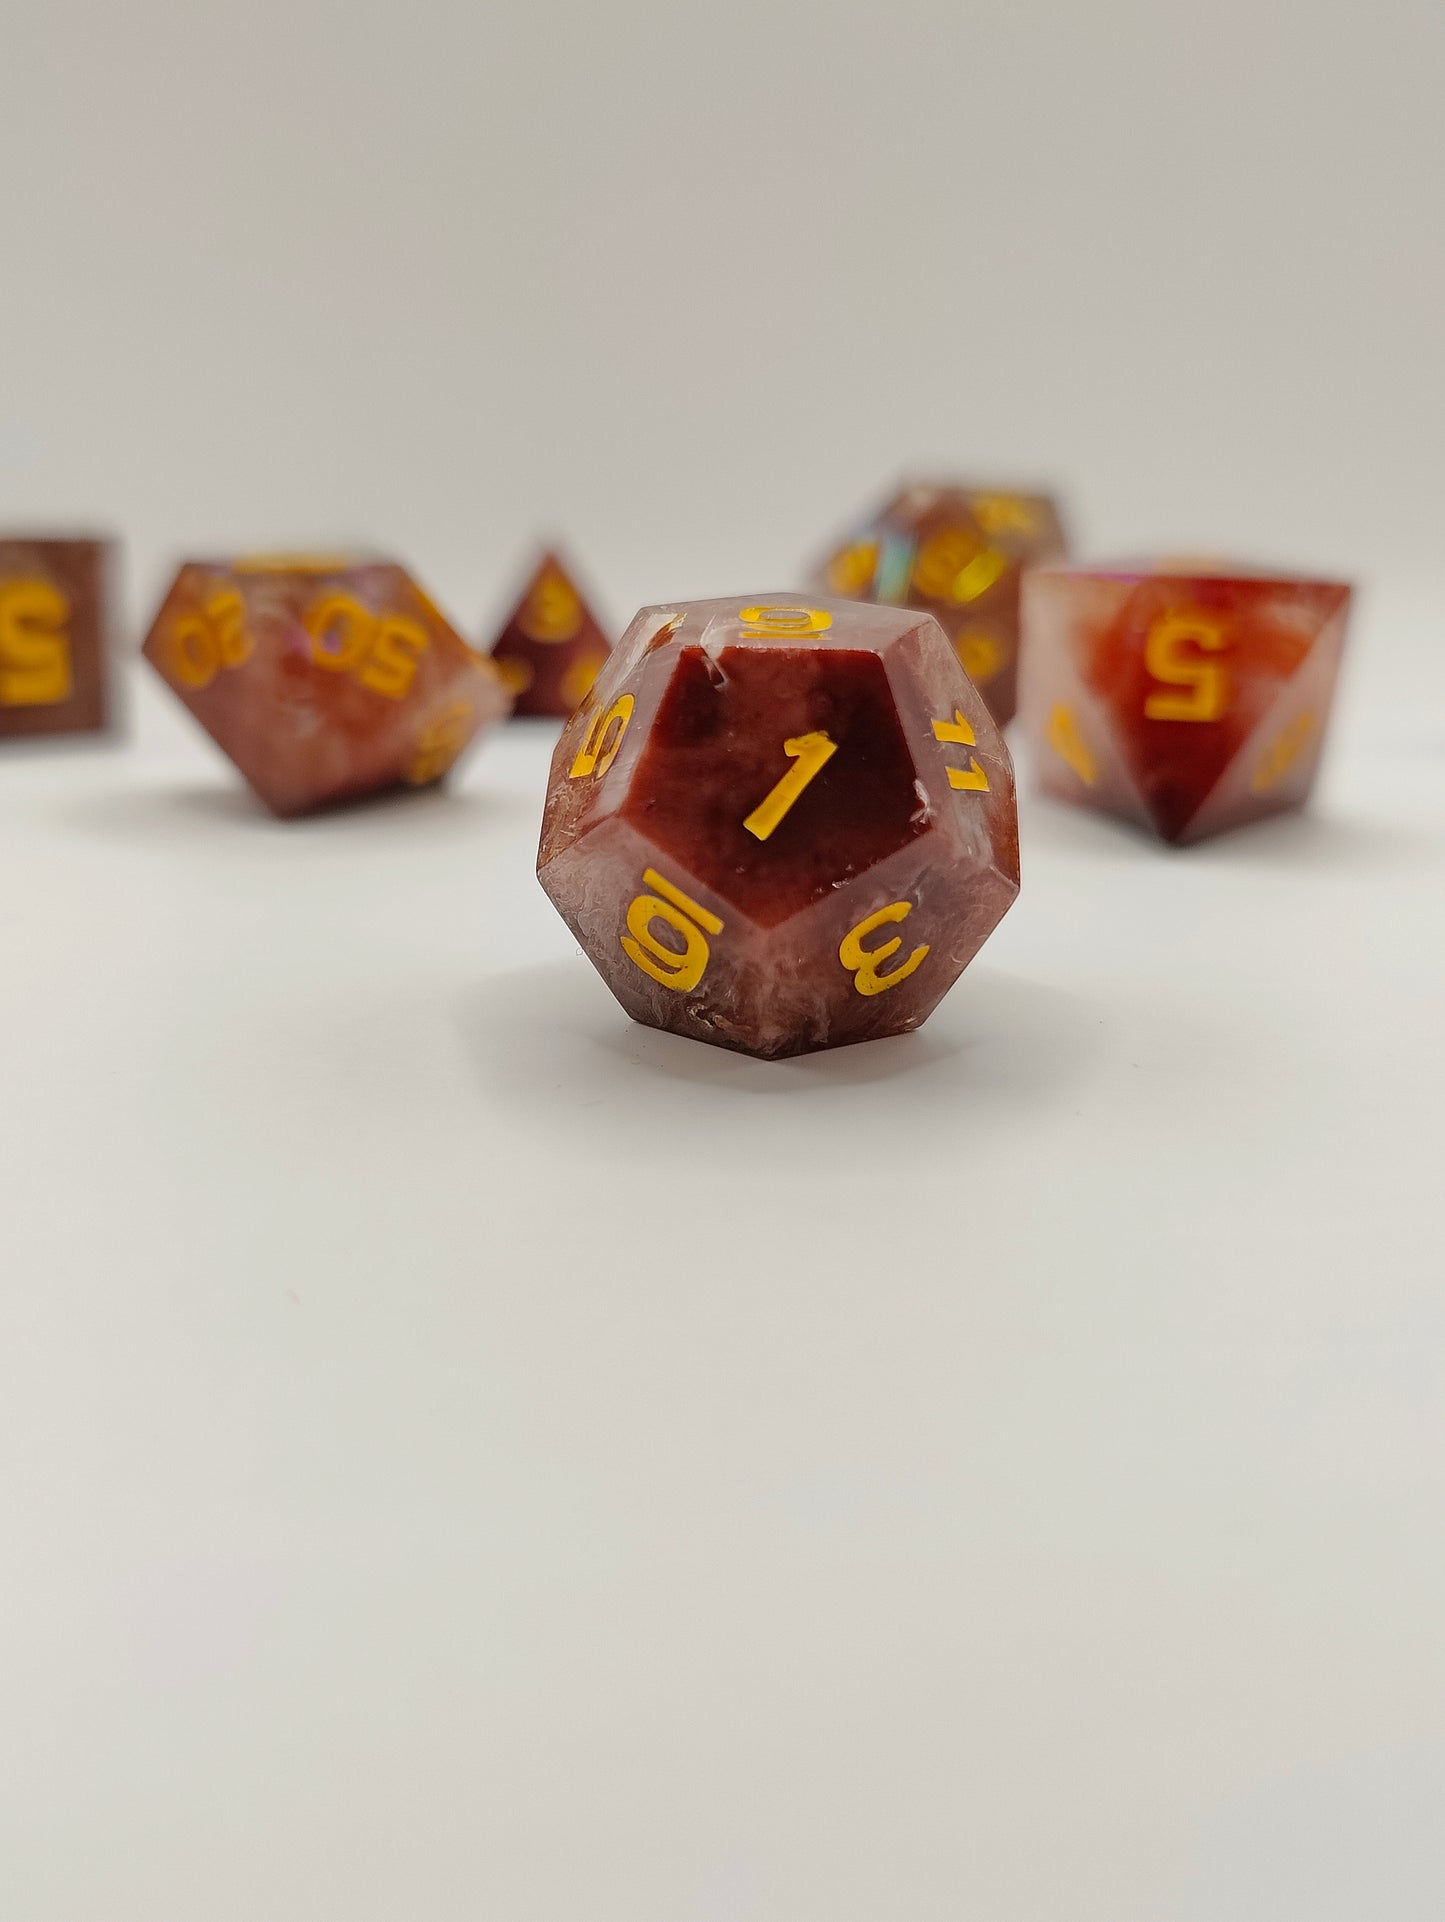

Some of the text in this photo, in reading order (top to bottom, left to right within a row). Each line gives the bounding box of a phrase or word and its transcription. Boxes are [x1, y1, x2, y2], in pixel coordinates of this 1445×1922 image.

[743, 731, 837, 840] 1
[931, 710, 989, 792] 11
[840, 902, 929, 996] 3
